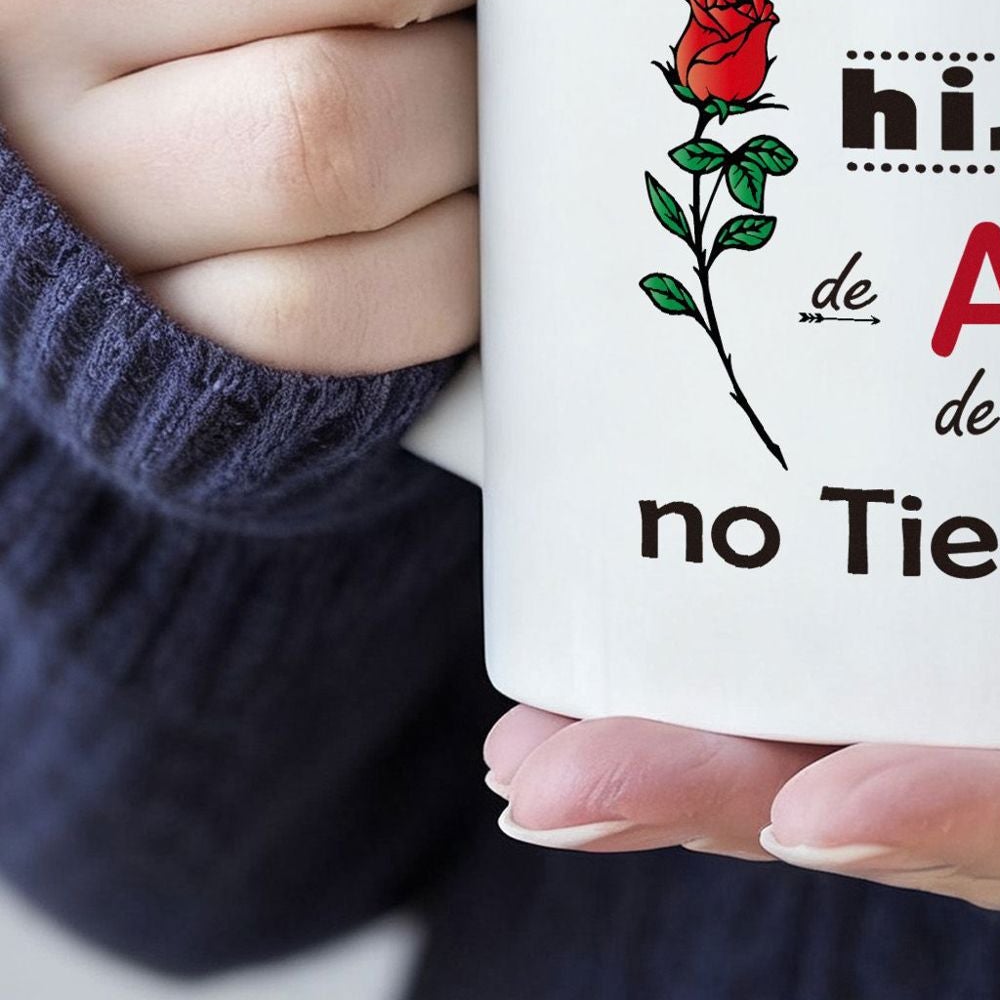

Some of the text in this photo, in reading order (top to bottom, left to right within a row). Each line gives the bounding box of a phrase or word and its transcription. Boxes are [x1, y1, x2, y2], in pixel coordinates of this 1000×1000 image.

[812, 252, 877, 311] de
[935, 368, 1000, 436] de
[639, 500, 780, 569] no
